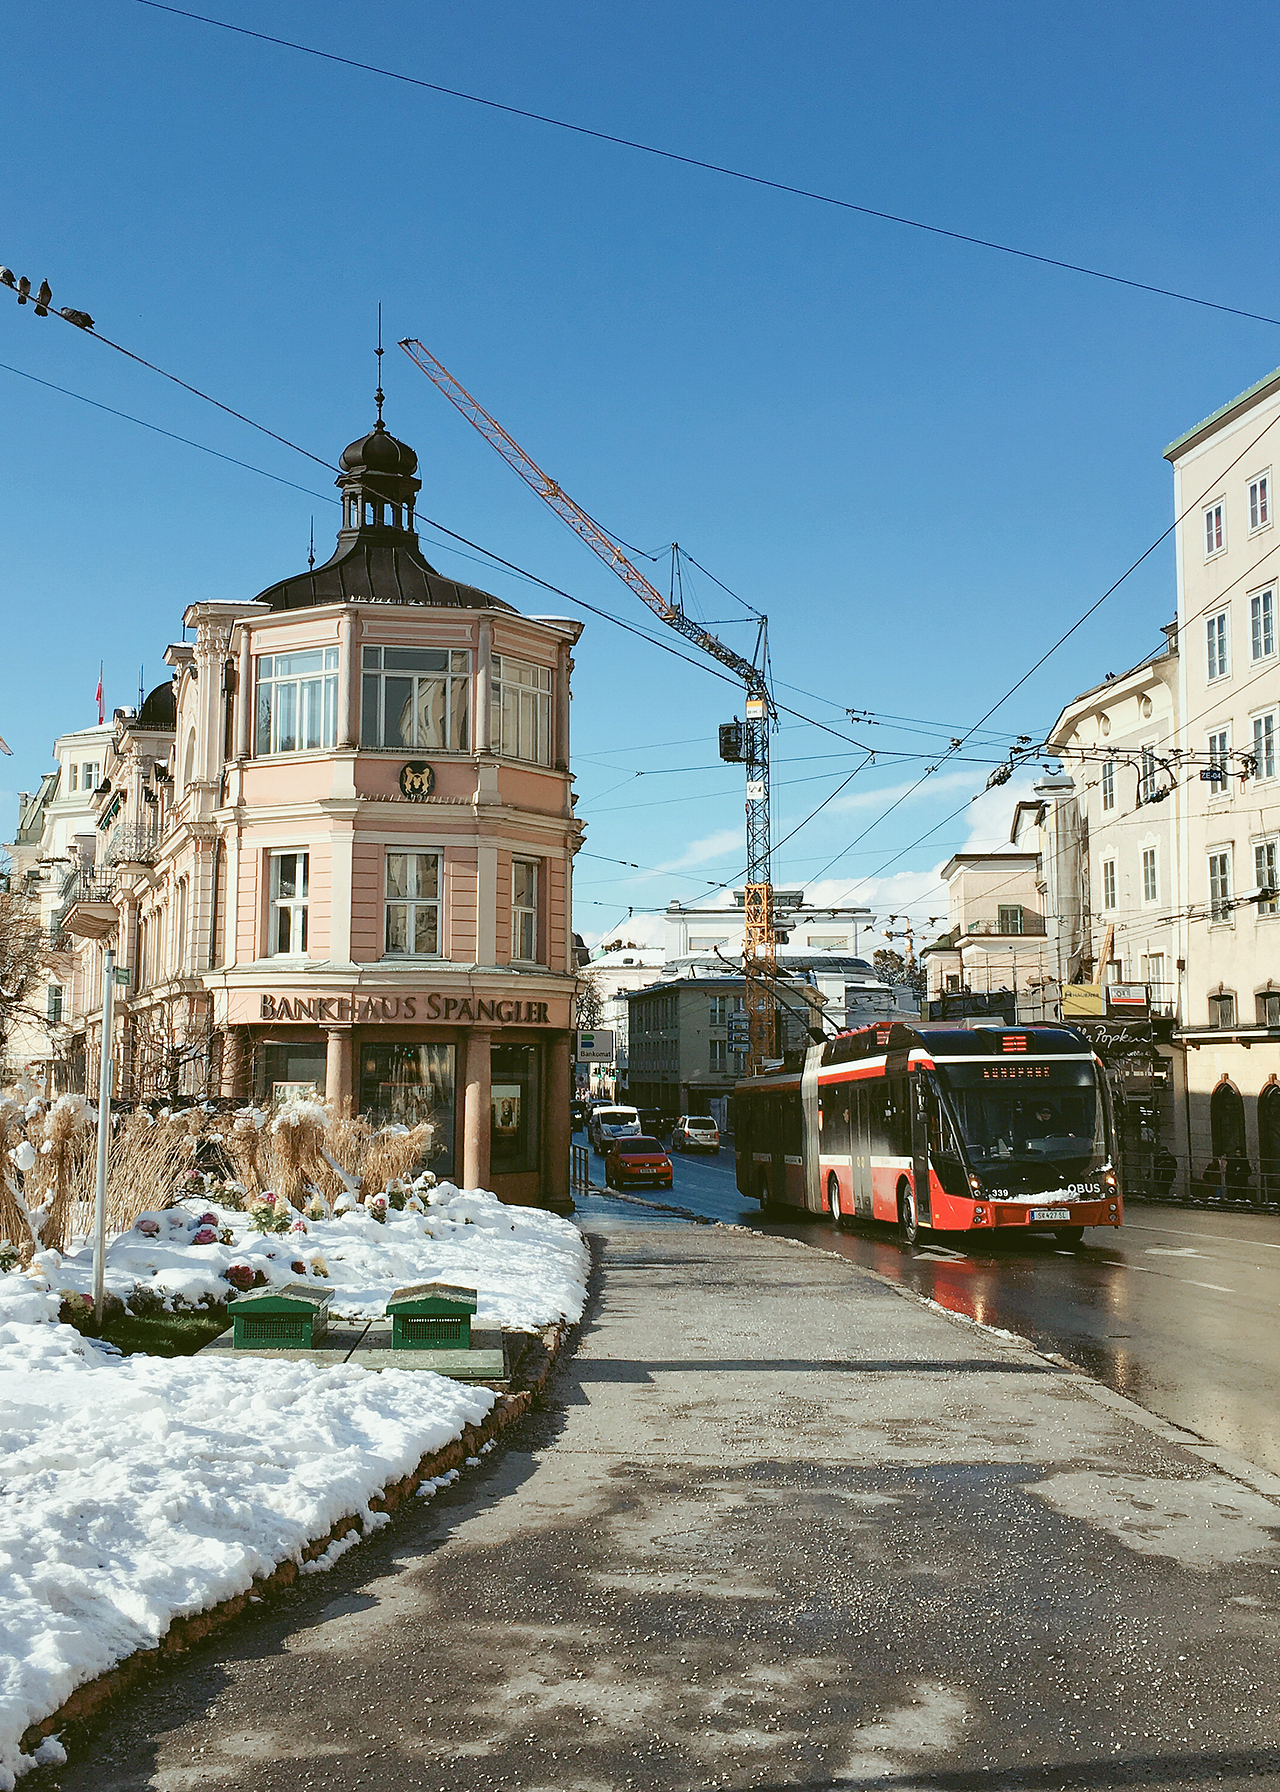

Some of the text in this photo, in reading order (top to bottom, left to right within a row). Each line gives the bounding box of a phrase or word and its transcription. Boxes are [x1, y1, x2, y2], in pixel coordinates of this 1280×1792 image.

[260, 993, 551, 1023] BANKHAUS SPÄNGLER
[991, 1189, 1009, 1197] 339
[1067, 1183, 1101, 1194] OBUS
